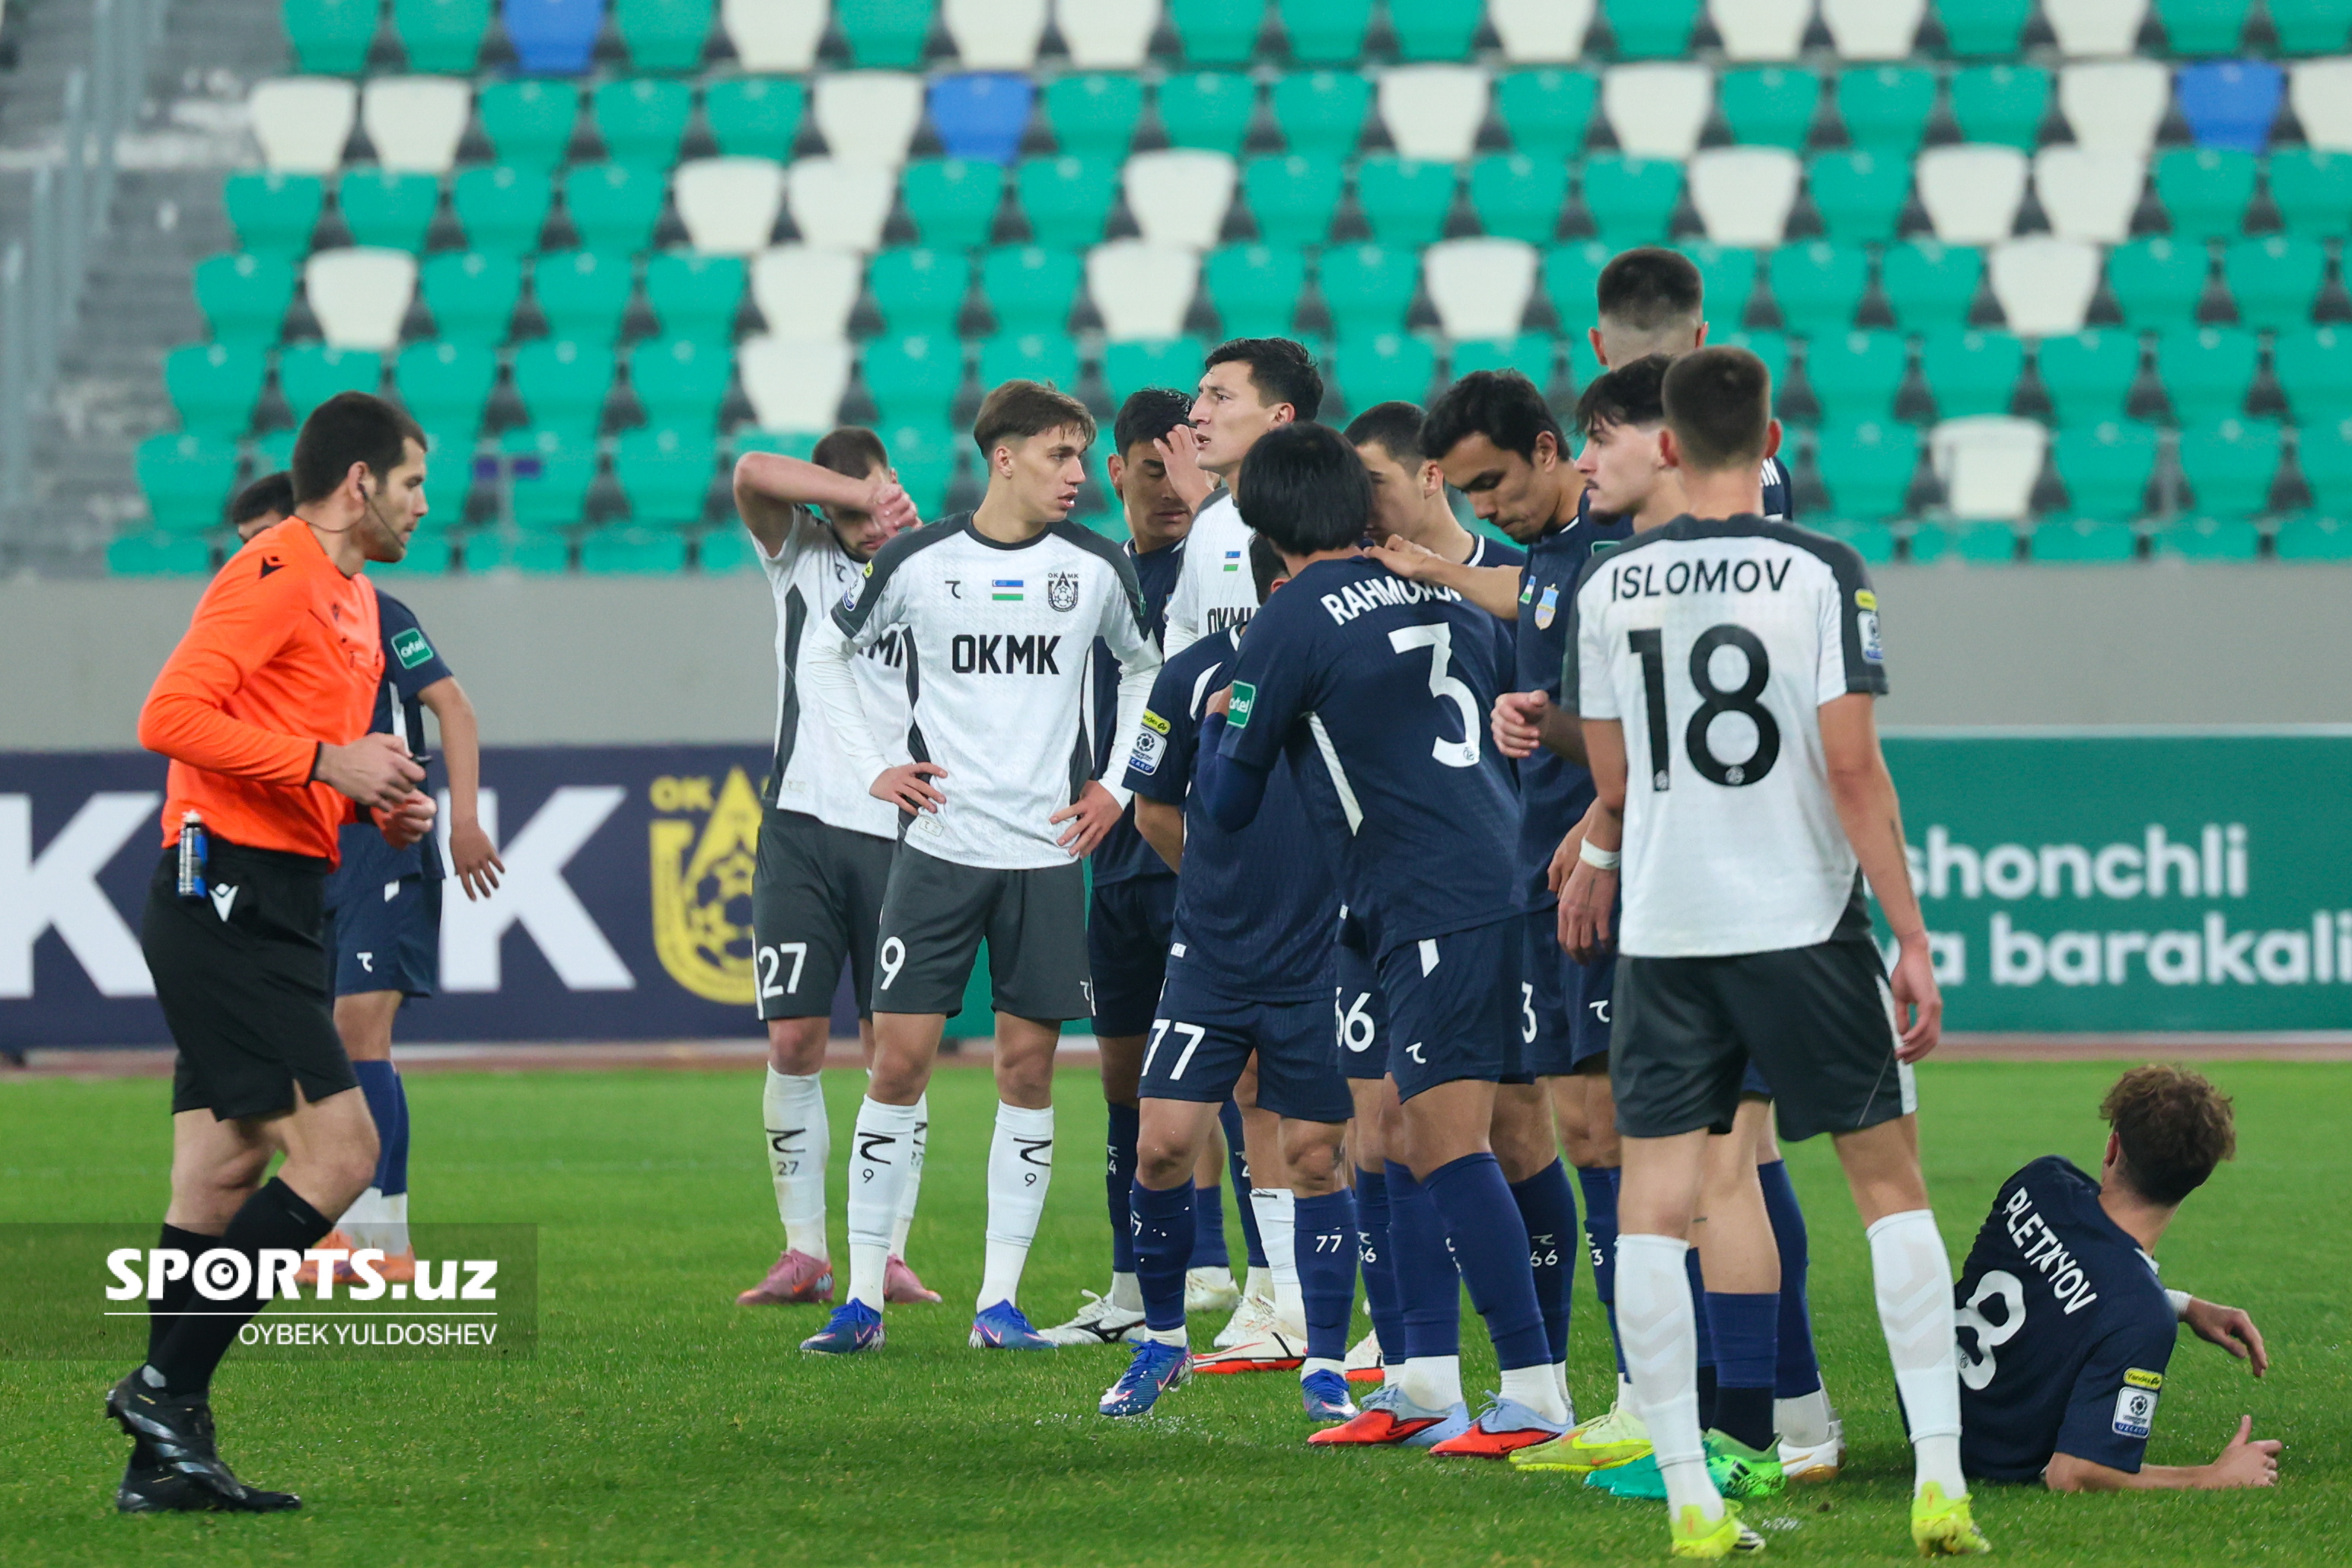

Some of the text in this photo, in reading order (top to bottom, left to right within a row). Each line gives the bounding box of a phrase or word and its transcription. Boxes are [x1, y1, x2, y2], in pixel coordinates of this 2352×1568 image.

[1611, 557, 1793, 603] ISLOMOV
[951, 633, 1062, 676] OKMK
[1388, 622, 1480, 768] 3
[1627, 623, 1780, 792] 18
[758, 942, 808, 999] 27
[880, 936, 906, 991] 9
[1141, 1018, 1206, 1081] 77
[776, 1161, 799, 1176] 27
[862, 1168, 875, 1184] 9
[1025, 1172, 1037, 1187] 9
[1108, 1159, 1117, 1174] 4
[1315, 1235, 1343, 1253] 77
[1529, 1249, 1559, 1267] 66
[2002, 1187, 2098, 1316] PLETNYOV
[1955, 1269, 2027, 1391] 8
